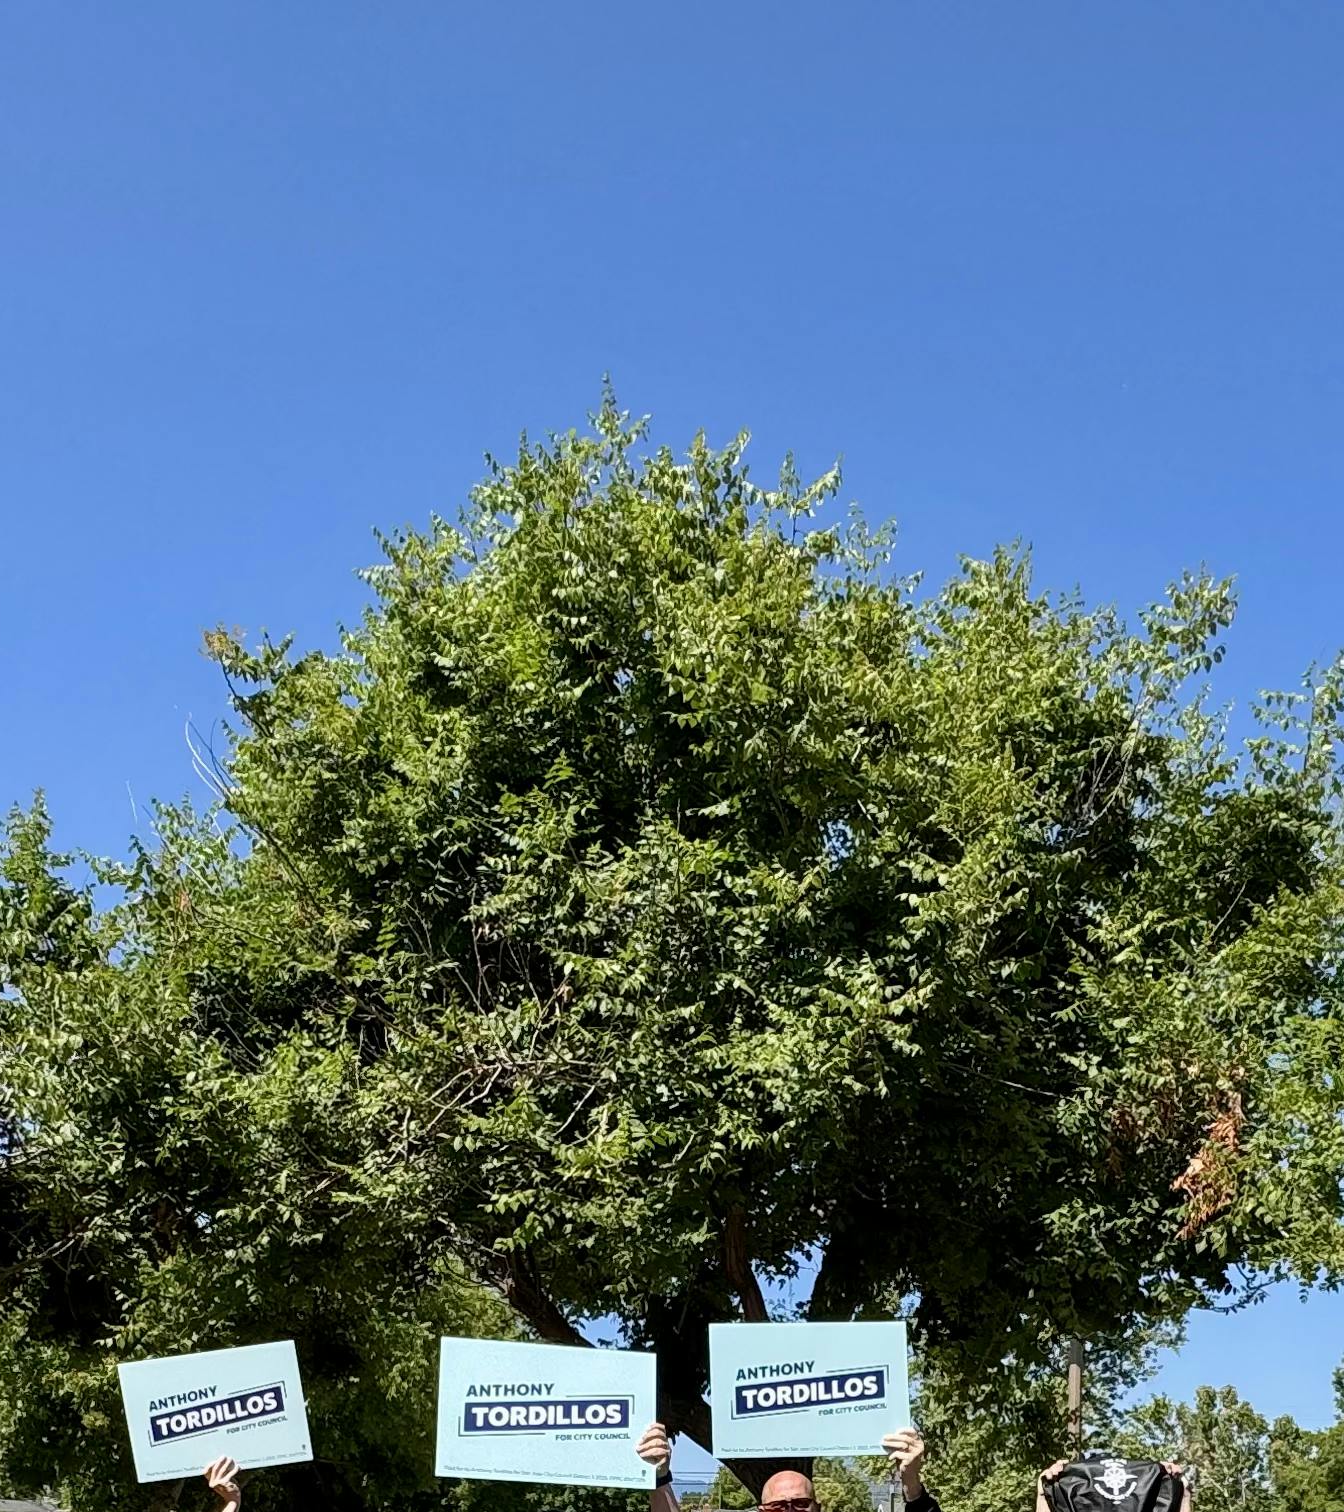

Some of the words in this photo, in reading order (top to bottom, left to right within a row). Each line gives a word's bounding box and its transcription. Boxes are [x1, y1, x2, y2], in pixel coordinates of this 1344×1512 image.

[736, 1360, 815, 1381] ANTHONY
[149, 1385, 218, 1412] ANTHONY
[466, 1383, 555, 1397] ANTHONY
[742, 1376, 878, 1409] TORDILLOS
[156, 1392, 277, 1436] TORDILLOS
[472, 1404, 622, 1427] TORDILLOS
[818, 1408, 833, 1416] FOR
[853, 1403, 887, 1412] COUNCIL
[227, 1425, 240, 1435] FOR
[242, 1422, 257, 1432] CITY
[257, 1416, 288, 1428] COUNCIL
[574, 1433, 592, 1441] CITY
[595, 1432, 631, 1440] COUNCIL
